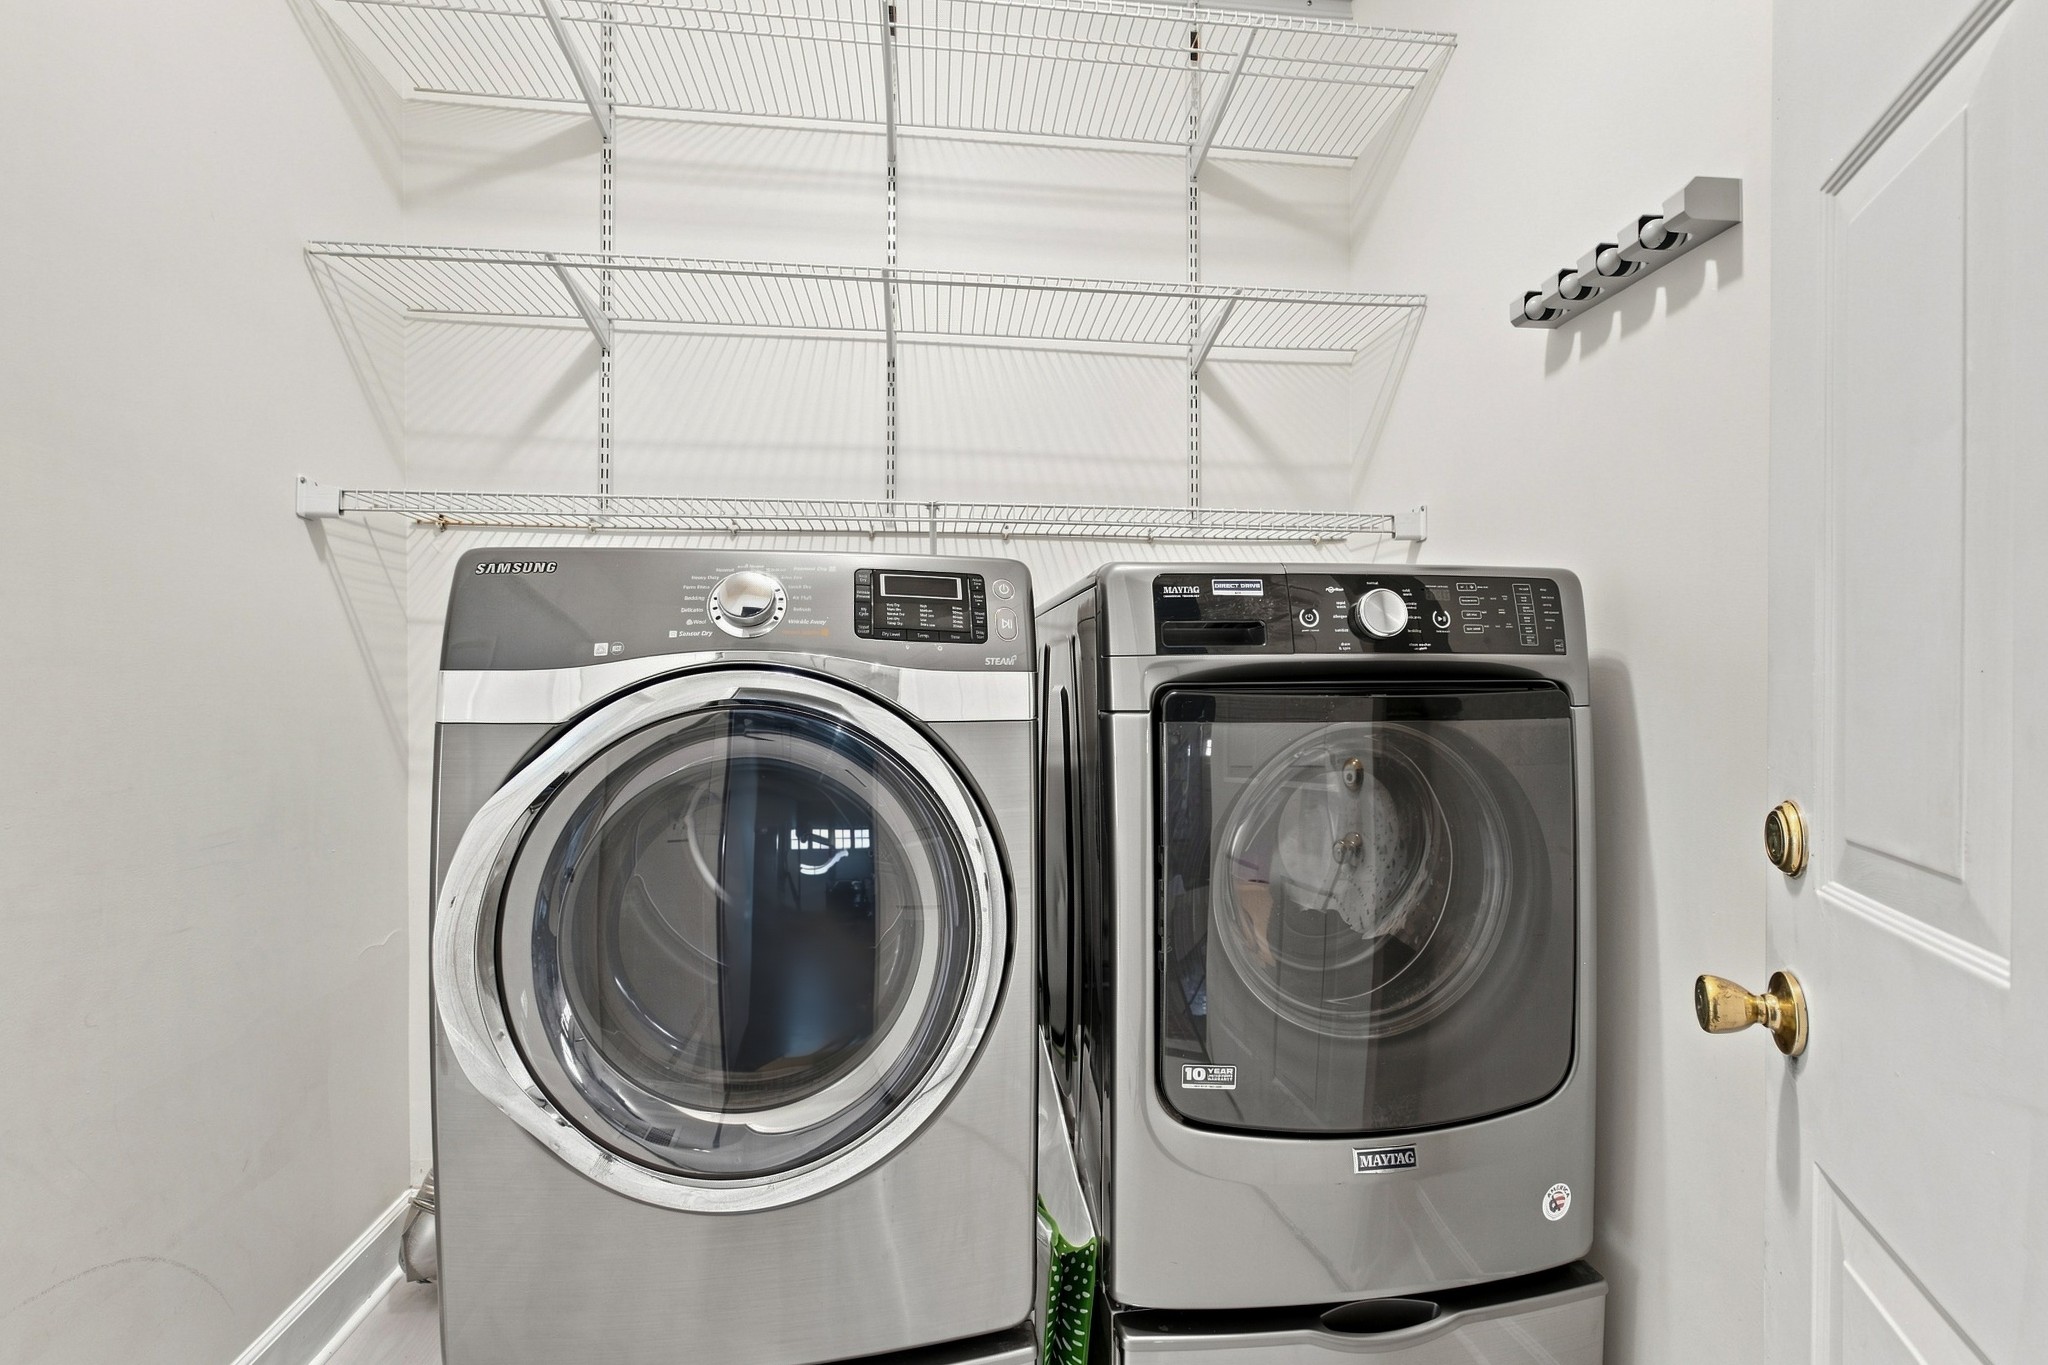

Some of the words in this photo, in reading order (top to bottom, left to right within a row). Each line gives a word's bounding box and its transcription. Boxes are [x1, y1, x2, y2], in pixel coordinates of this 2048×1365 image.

[475, 562, 558, 575] SAMSUNG
[1163, 586, 1200, 594] MAYTAG
[985, 657, 1015, 665] STEAM
[1185, 1067, 1206, 1081] 10
[1359, 1151, 1415, 1168] MAYTAG
